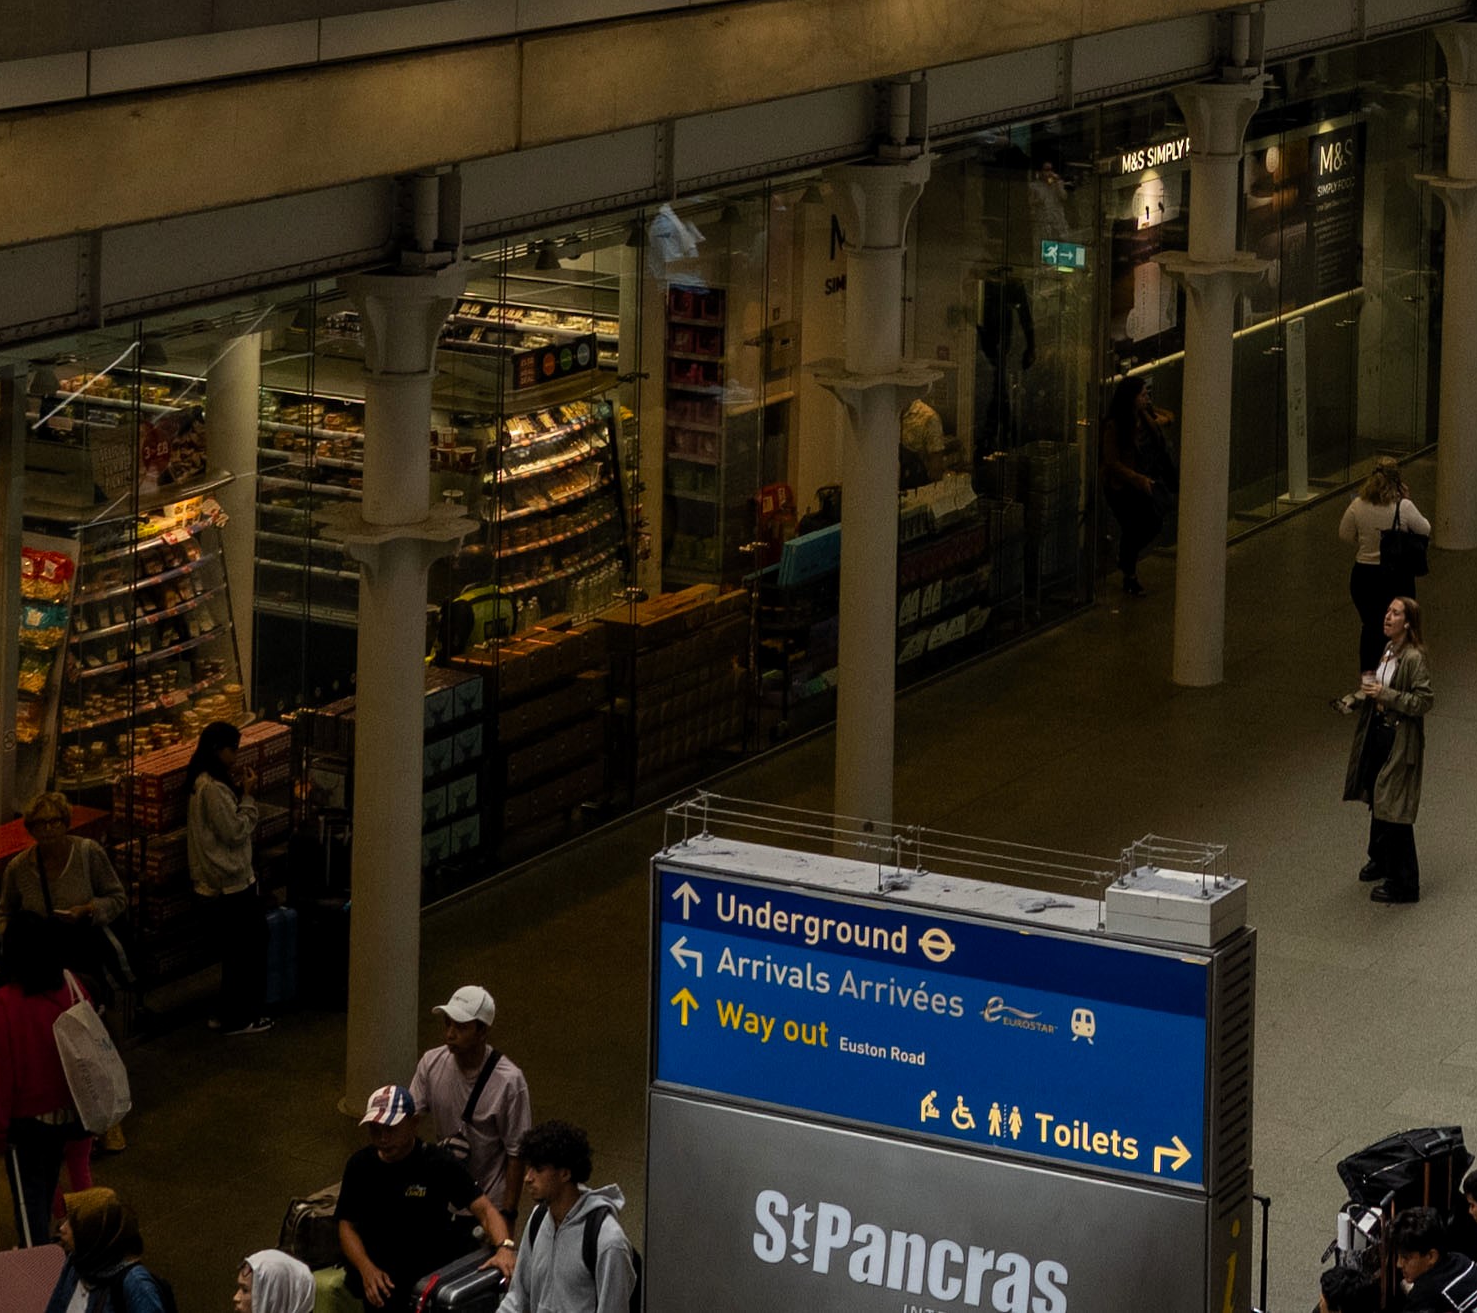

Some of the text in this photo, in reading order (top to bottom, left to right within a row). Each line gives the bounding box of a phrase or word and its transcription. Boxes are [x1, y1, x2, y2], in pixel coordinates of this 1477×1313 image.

[1121, 149, 1146, 174] M&S
[1146, 138, 1186, 168] SIMPLY
[1318, 138, 1354, 176] M&S
[1316, 181, 1339, 198] SIMPLY
[715, 893, 909, 954] Underground
[716, 947, 832, 995] Arrivals
[838, 970, 965, 1019] Arrivées
[716, 1000, 926, 1066] Way out Euston Road
[1034, 1112, 1140, 1161] Toilets
